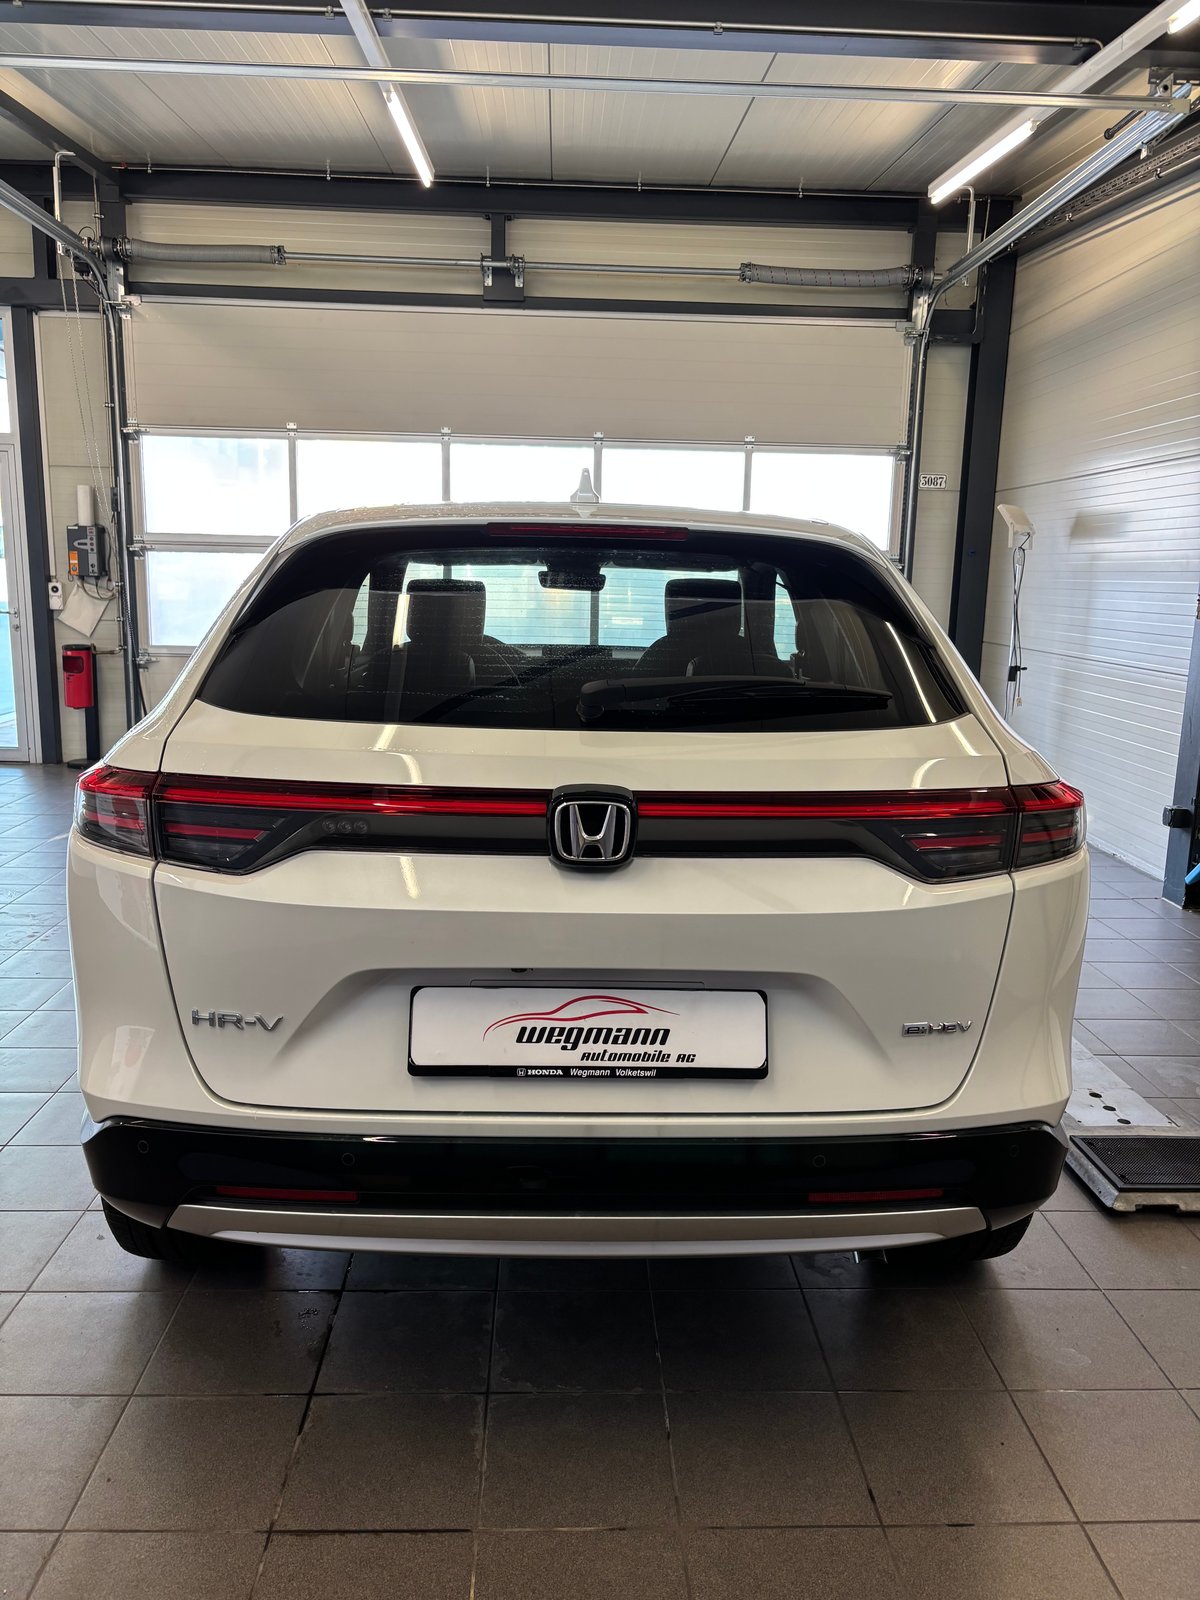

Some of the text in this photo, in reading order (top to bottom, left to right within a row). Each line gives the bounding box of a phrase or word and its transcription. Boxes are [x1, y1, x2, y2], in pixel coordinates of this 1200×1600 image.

[921, 476, 944, 487] 3087
[192, 1008, 283, 1031] HR-V
[516, 1026, 670, 1050] wegmann
[675, 1053, 696, 1063] AG
[570, 1068, 610, 1077] Wegmann
[615, 1068, 656, 1077] Volketswil
